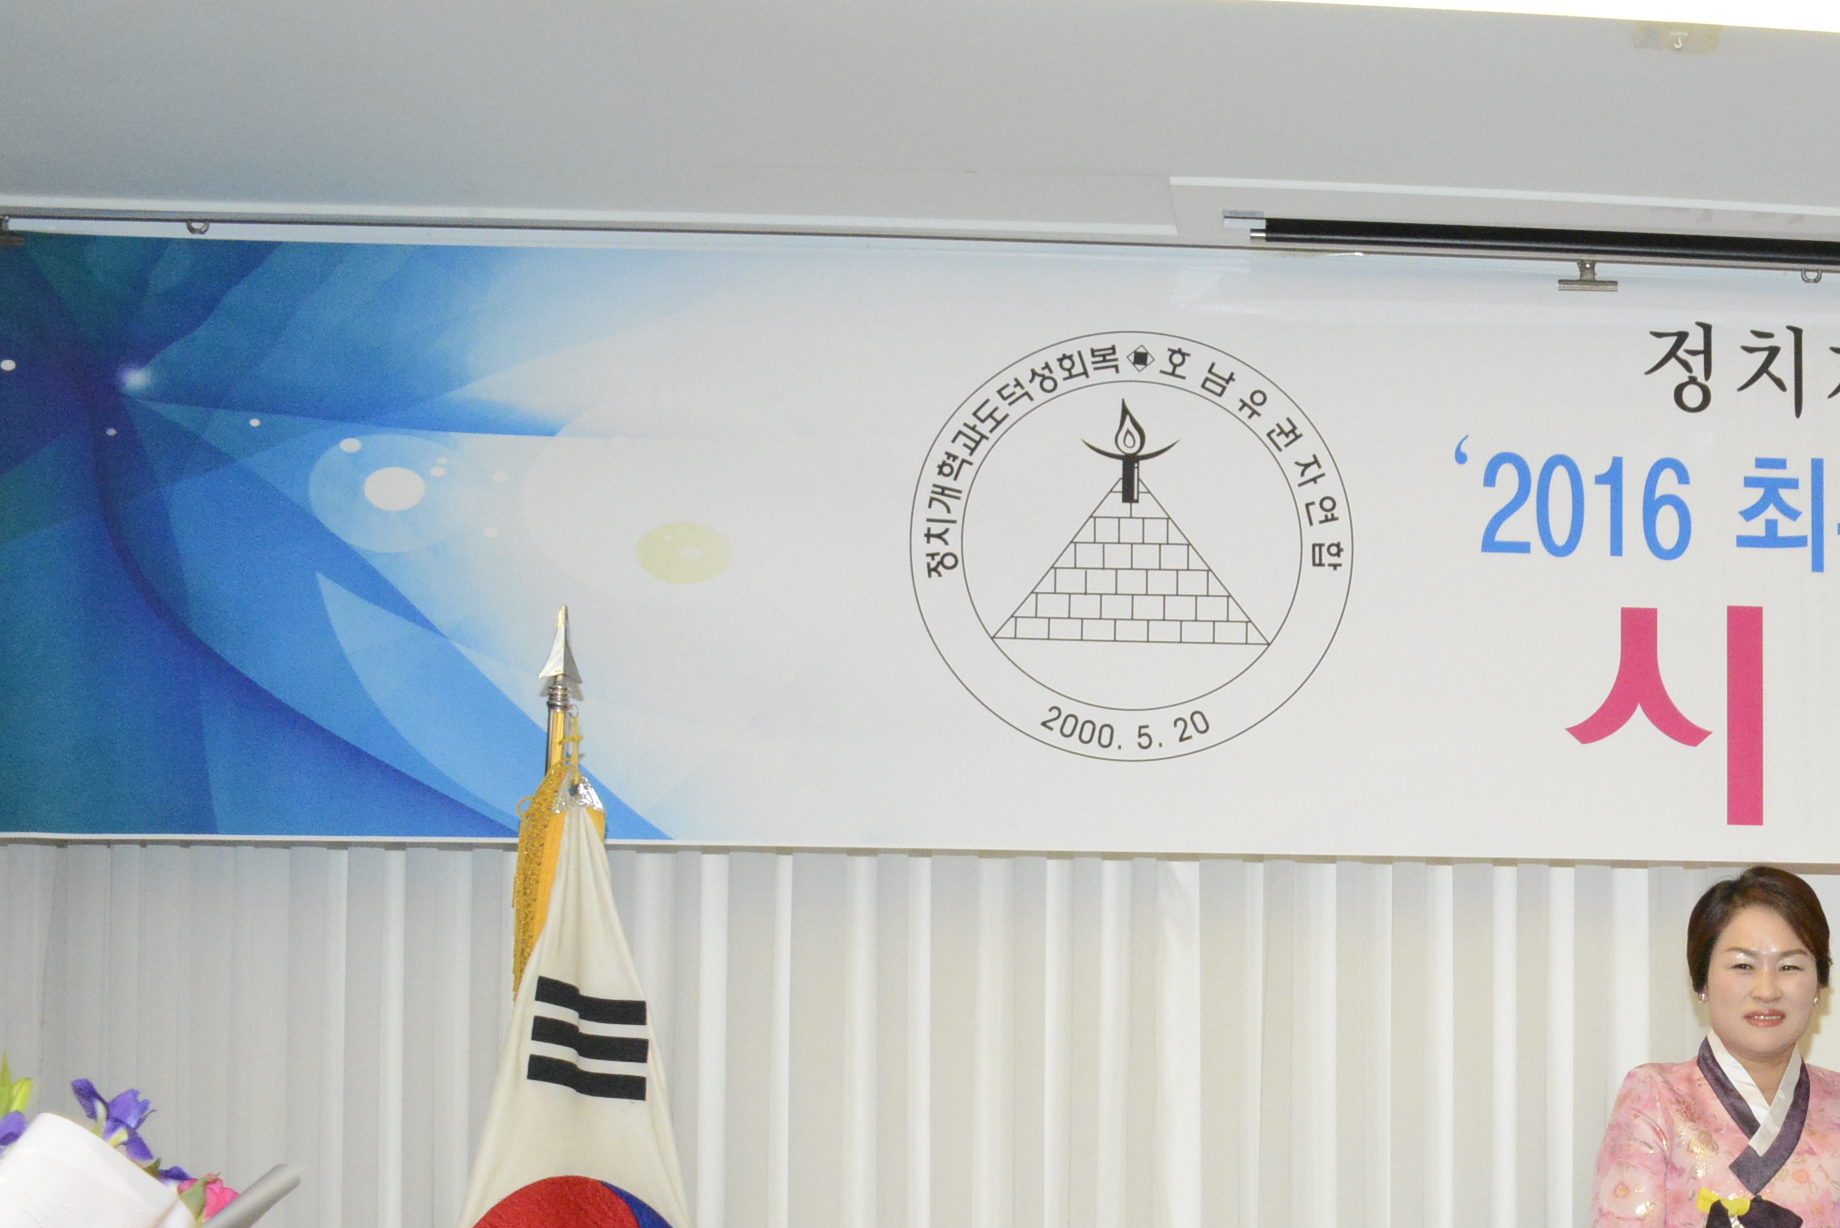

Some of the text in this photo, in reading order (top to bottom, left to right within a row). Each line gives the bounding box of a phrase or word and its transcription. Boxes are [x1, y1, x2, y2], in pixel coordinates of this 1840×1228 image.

[923, 344, 1121, 579] 정치개혁과도덕성회복
[1158, 346, 1345, 572] 호남유권자연합
[1173, 710, 1210, 743] 20
